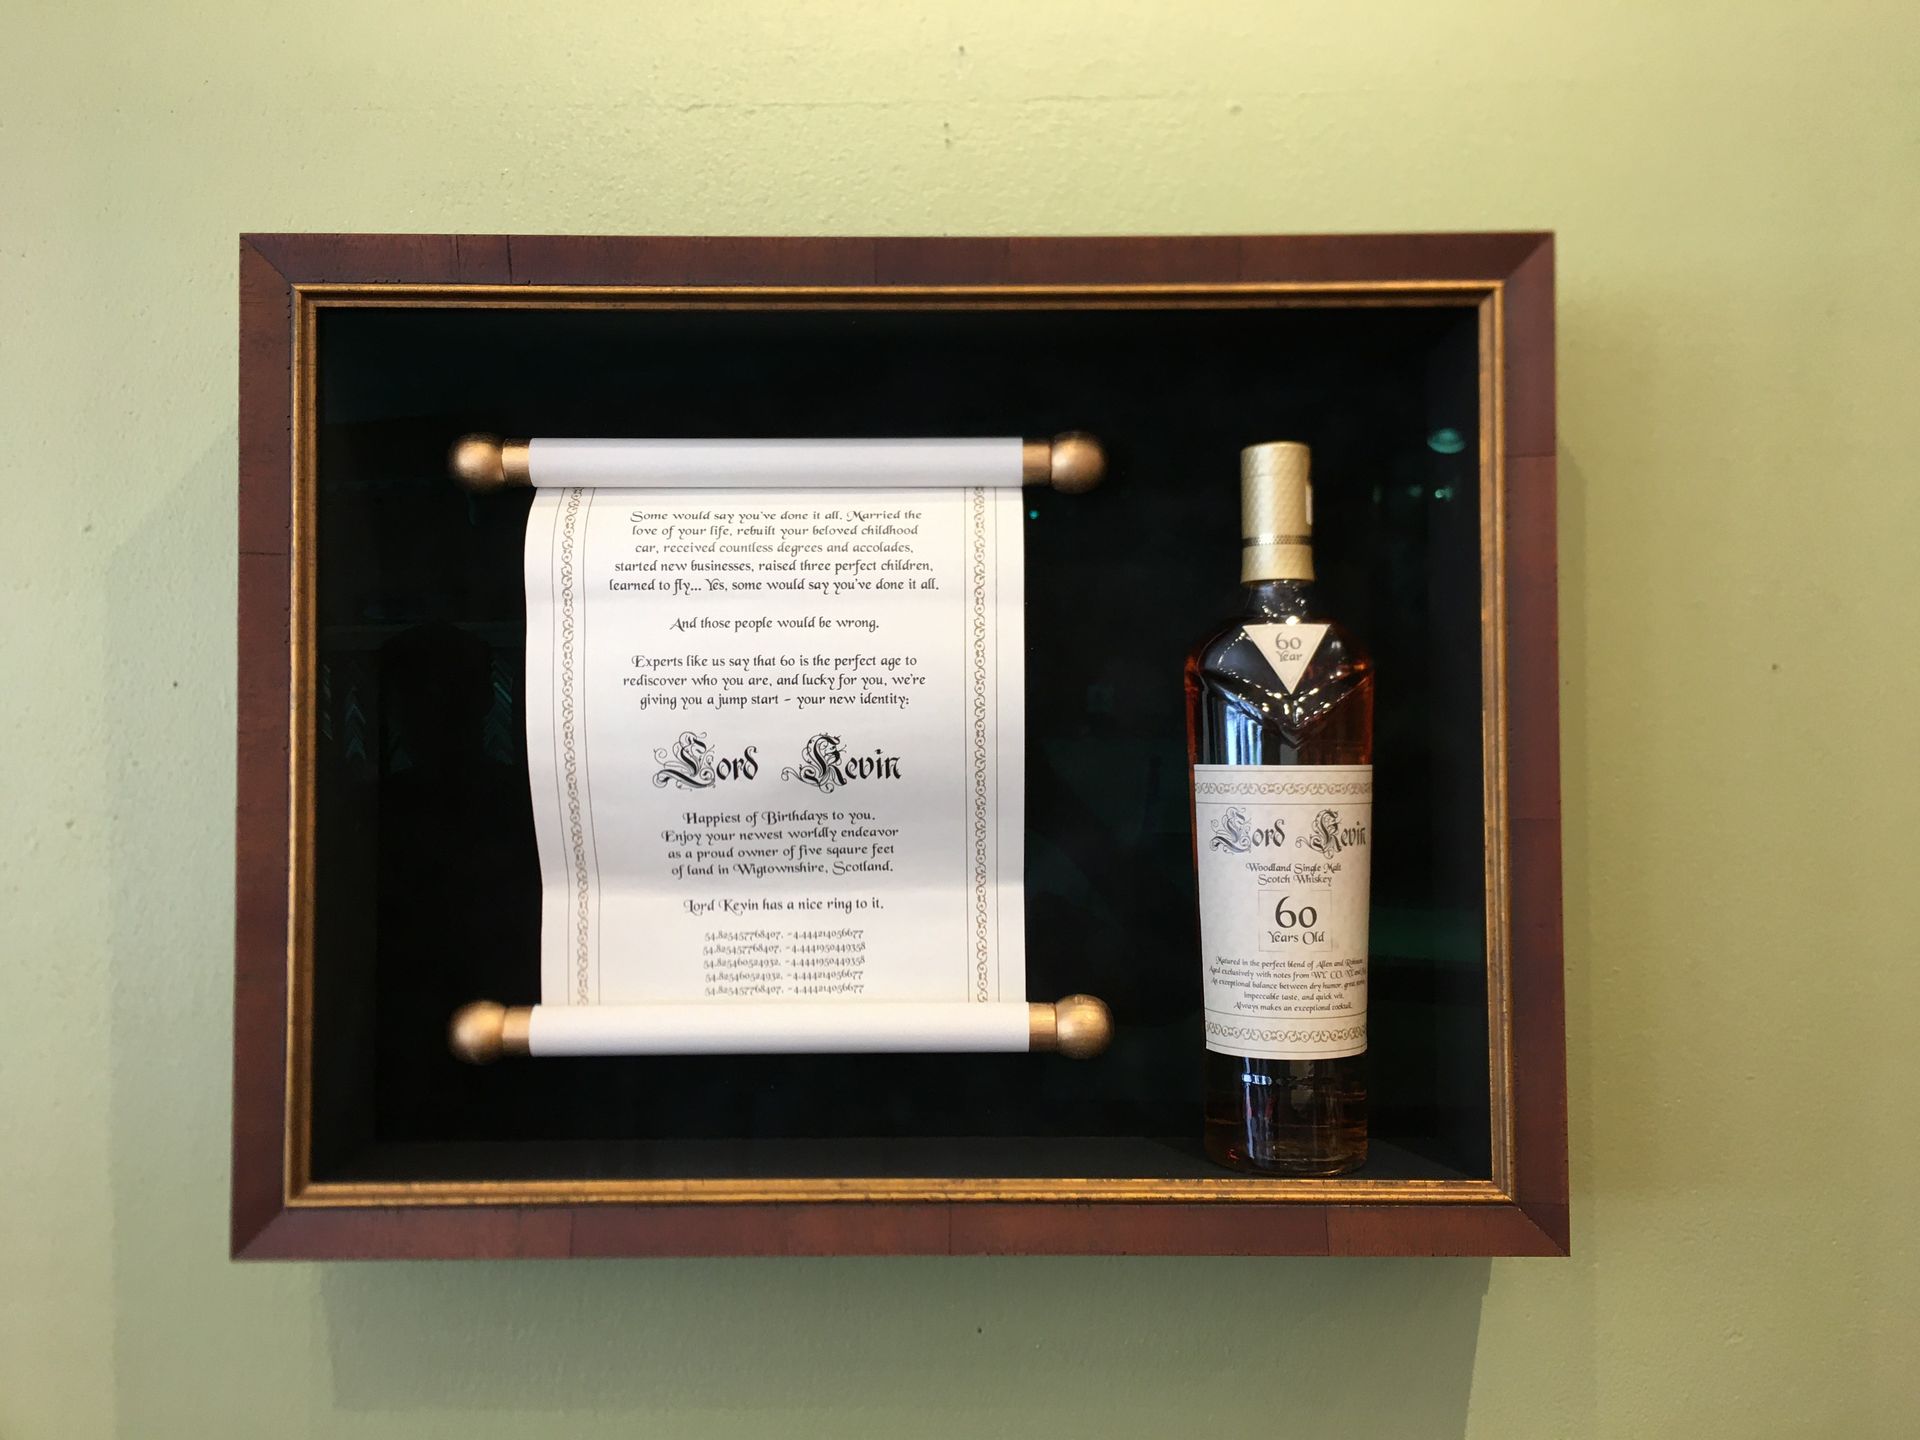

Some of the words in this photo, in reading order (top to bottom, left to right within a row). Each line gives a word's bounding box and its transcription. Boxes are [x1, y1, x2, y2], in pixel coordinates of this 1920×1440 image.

[630, 511, 668, 522] Some
[672, 511, 711, 520] would
[714, 513, 735, 524] say
[780, 511, 808, 520] done
[813, 511, 820, 520] it
[824, 510, 843, 520] all.
[846, 510, 901, 522] Married
[904, 510, 922, 519] the
[632, 525, 658, 535] love
[661, 525, 675, 540] of
[678, 528, 707, 540] your
[710, 525, 733, 540] life,
[737, 525, 775, 536] rebuilt
[780, 528, 809, 540] your
[812, 525, 858, 535] beloved
[861, 525, 919, 535] childhood
[635, 545, 659, 554] car,
[664, 541, 717, 553] received
[719, 542, 774, 553] countless
[777, 541, 823, 558] degrees
[826, 541, 850, 552] and
[852, 541, 914, 553] accolades,
[615, 559, 658, 571] started
[661, 563, 688, 572] new
[691, 560, 754, 572] businesses,
[759, 559, 797, 571] raised
[800, 559, 831, 571] three
[835, 559, 876, 576] perfect
[881, 559, 933, 572] children,
[609, 578, 656, 591] learned
[659, 581, 671, 591] to
[672, 578, 702, 596] fly...
[705, 578, 728, 592] Yes,
[732, 582, 762, 590] some
[766, 578, 806, 590] would
[808, 581, 829, 595] say
[875, 578, 904, 590] done
[908, 578, 916, 590] it
[920, 578, 939, 590] all.
[669, 617, 698, 632] And
[701, 617, 731, 629] those
[735, 616, 773, 633] people
[777, 616, 816, 628] would
[819, 616, 832, 628] be
[836, 619, 879, 633] wrong.
[1275, 632, 1302, 650] 60
[631, 655, 683, 671] Experts
[686, 655, 708, 667] like
[712, 658, 726, 666] us
[729, 658, 750, 672] say
[753, 654, 776, 666] that
[780, 655, 795, 666] 60
[800, 654, 809, 666] is
[813, 654, 831, 666] the
[834, 654, 876, 671] perfect
[880, 657, 901, 671] age
[905, 656, 917, 666] to
[1275, 650, 1303, 662] Year
[623, 674, 687, 686] rediscover
[691, 674, 718, 686] who
[722, 677, 744, 691] you
[748, 677, 772, 687] are,
[776, 673, 799, 685] and
[802, 674, 836, 691] lucky
[835, 673, 857, 690] for
[861, 676, 887, 691] you,
[640, 693, 677, 710] giving
[680, 696, 703, 710] you
[707, 697, 714, 705] a
[715, 693, 748, 710] jump
[751, 695, 779, 704] start
[797, 696, 826, 710] your
[829, 696, 856, 704] new
[860, 692, 909, 710] identity:
[652, 731, 758, 791] Lord
[781, 732, 901, 793] Kevin
[682, 812, 741, 828] Happiest
[745, 811, 759, 827] of
[761, 810, 828, 825] Birthdays
[832, 811, 844, 820] to
[848, 812, 875, 825] you.
[661, 830, 702, 846] Enjoy
[706, 833, 736, 846] your
[739, 830, 783, 840] newest
[787, 827, 837, 842] worldly
[841, 826, 899, 837] endeavor
[1210, 807, 1286, 855] Lord
[1295, 809, 1366, 860] Kevin
[668, 851, 681, 859] as
[685, 851, 692, 859] a
[696, 847, 734, 863] proud
[737, 849, 778, 858] owner
[782, 845, 796, 861] of
[797, 844, 822, 861] five
[826, 846, 868, 858] sqaure
[871, 843, 894, 859] feet
[671, 865, 684, 880] of
[687, 861, 714, 875] land
[718, 864, 729, 875] in
[733, 863, 828, 879] Wigtownshire,
[832, 860, 893, 875] Scotland.
[1245, 862, 1292, 875] Woodland
[1293, 863, 1322, 875] Single
[1323, 863, 1341, 874] Malt
[1257, 874, 1290, 886] Scotch
[1293, 873, 1332, 887] Whiskey
[683, 899, 715, 916] Lord
[718, 899, 759, 915] Kevin
[763, 898, 783, 910] has
[787, 901, 794, 910] a
[798, 898, 823, 910] nice
[827, 897, 852, 914] ring
[856, 899, 868, 909] to
[872, 897, 884, 909] it.
[1275, 896, 1317, 928] 60
[1267, 931, 1299, 943] Years
[1302, 931, 1325, 945] Old
